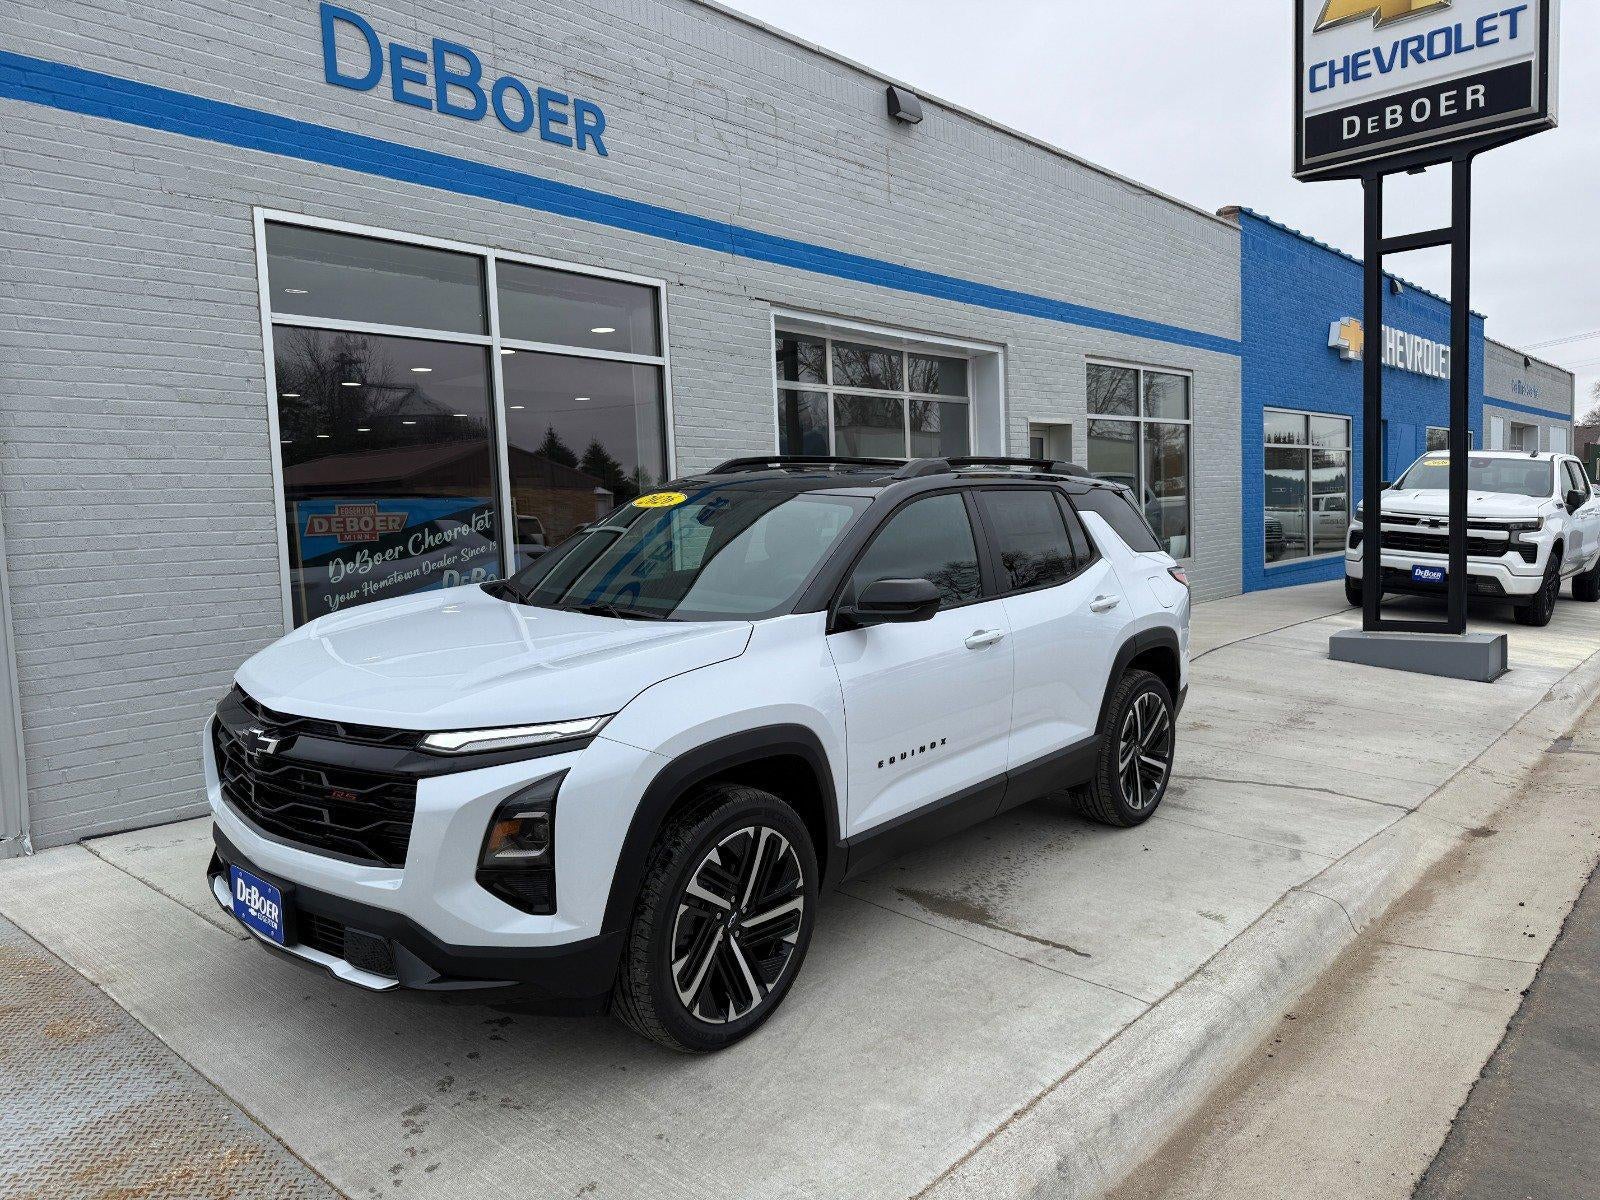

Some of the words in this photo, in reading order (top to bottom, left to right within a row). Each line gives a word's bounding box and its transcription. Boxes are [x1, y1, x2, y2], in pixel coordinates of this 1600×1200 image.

[1308, 4, 1528, 93] CHEVROLET
[313, 516, 400, 533] DEBOER
[328, 545, 404, 583] DeBoer
[408, 509, 495, 556] Chevrolet
[324, 588, 360, 611] Your
[361, 568, 421, 597] Hometown
[422, 554, 458, 575] Dealer
[460, 545, 487, 562] Since
[877, 737, 947, 769] EQUINOX
